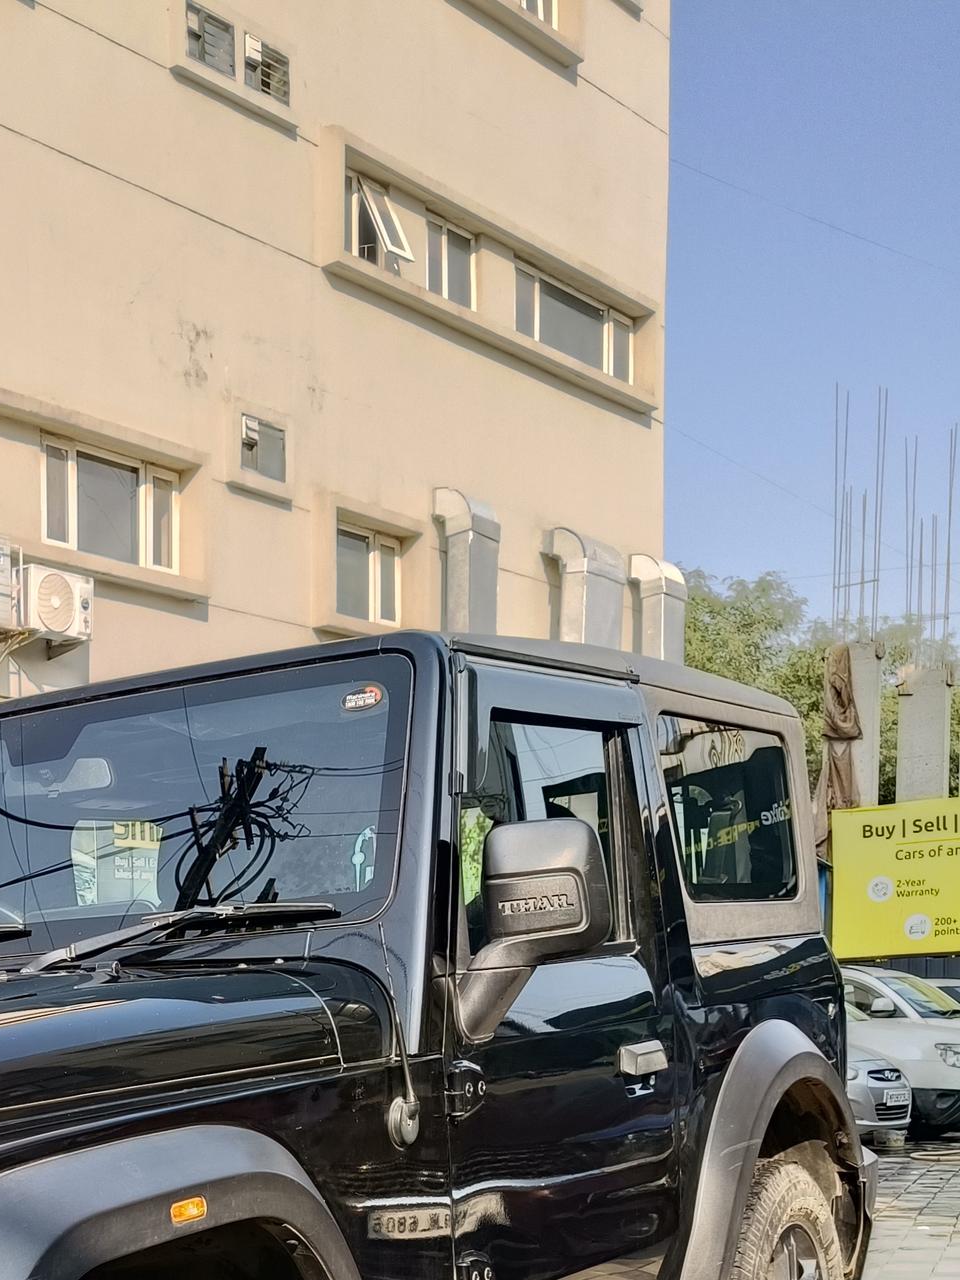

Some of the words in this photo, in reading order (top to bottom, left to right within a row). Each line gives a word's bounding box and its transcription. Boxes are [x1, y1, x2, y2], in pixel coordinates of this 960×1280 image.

[862, 824, 896, 840] Buy
[912, 815, 948, 834] Sell
[895, 849, 925, 860] Cars
[928, 845, 944, 858] of
[896, 879, 926, 888] 2-Year
[896, 887, 940, 898] Warranty
[498, 893, 575, 916] THAR
[934, 917, 957, 926] 200+
